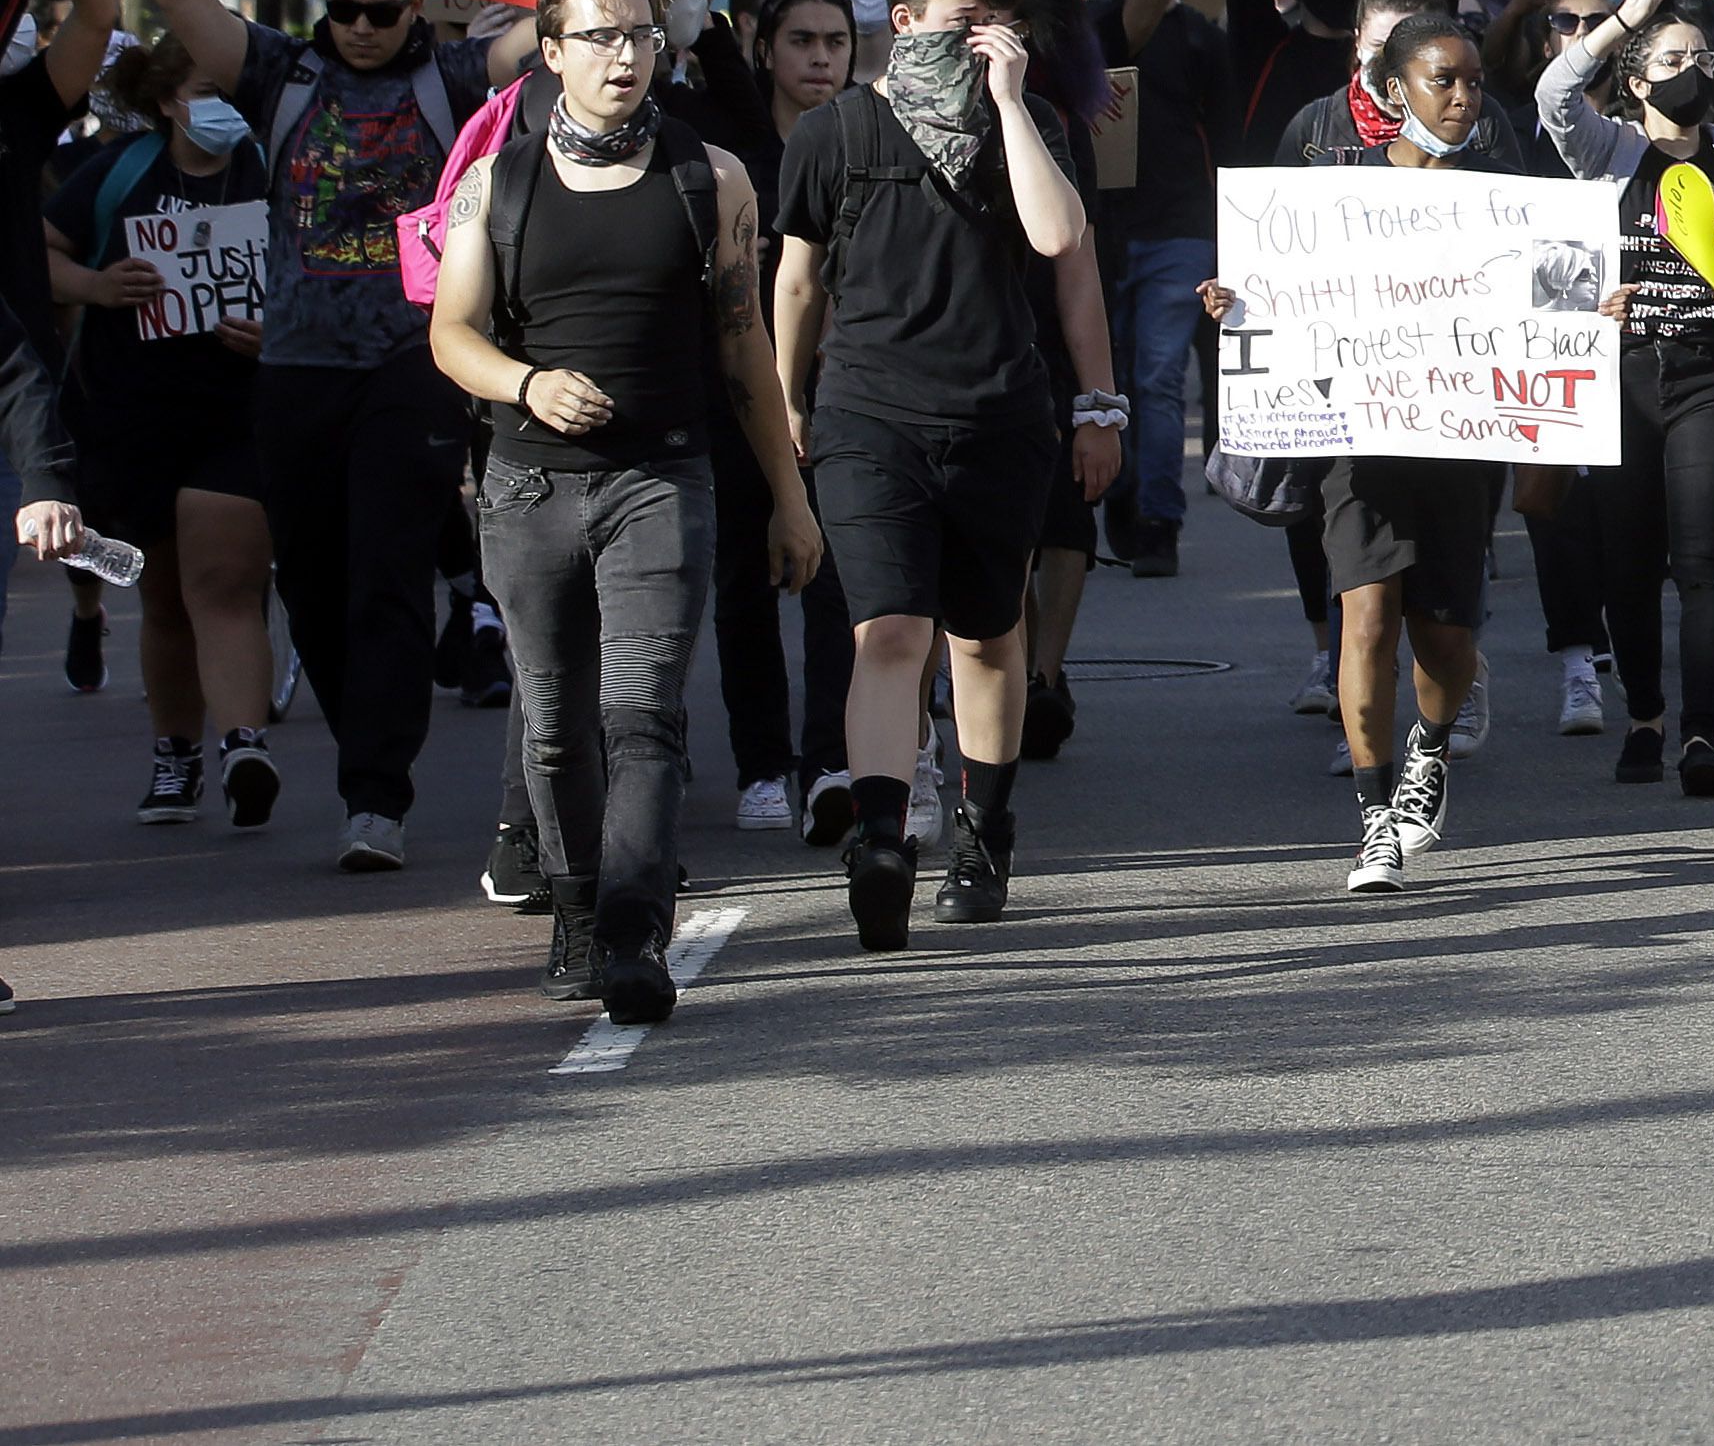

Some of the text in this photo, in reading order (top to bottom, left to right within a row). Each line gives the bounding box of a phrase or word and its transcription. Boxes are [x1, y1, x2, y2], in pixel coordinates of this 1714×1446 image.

[136, 219, 178, 252] NO
[1224, 188, 1536, 256] YOU Protest for
[139, 278, 266, 340] NO PEA
[1375, 270, 1493, 306] Haircuts
[1221, 316, 1608, 376] I Protest for Black
[1491, 369, 1596, 409] NOT
